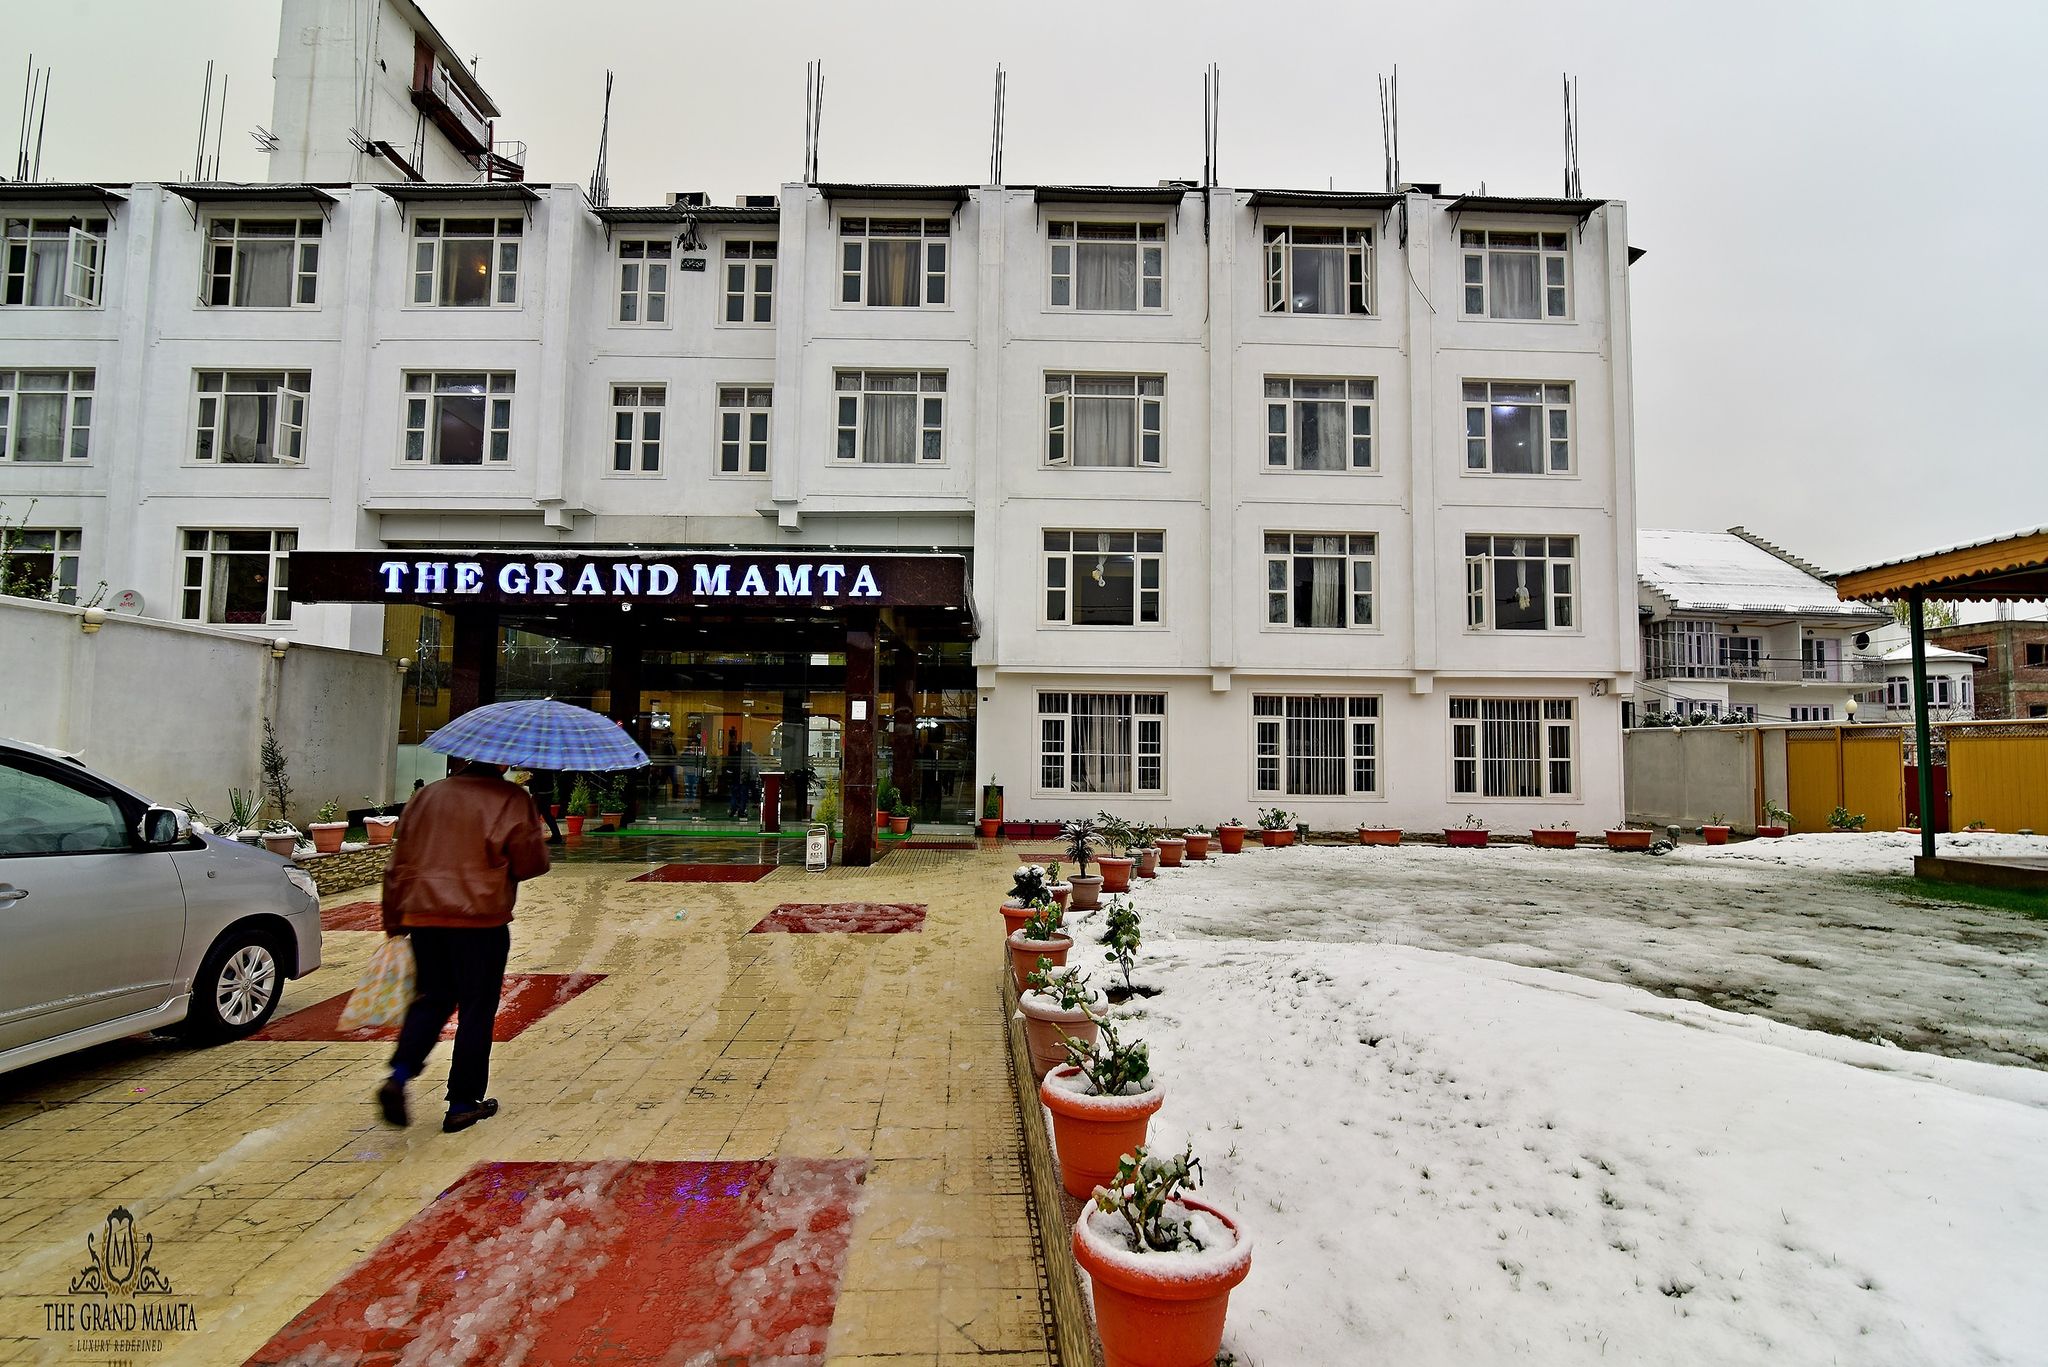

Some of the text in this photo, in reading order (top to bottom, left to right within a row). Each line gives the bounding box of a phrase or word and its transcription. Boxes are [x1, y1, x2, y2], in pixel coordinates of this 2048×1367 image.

[379, 561, 882, 597] THE GRAND MAMTA
